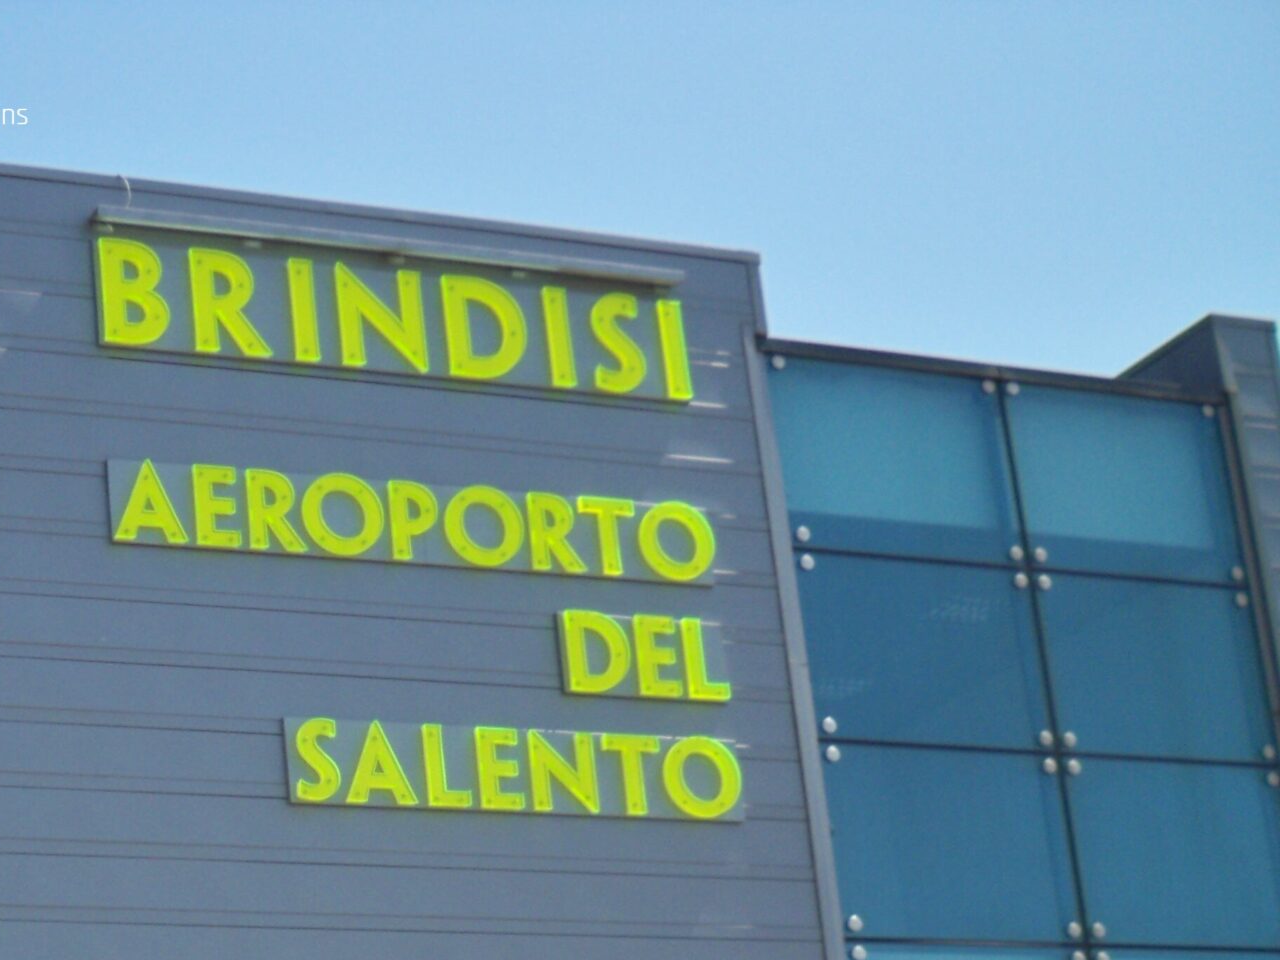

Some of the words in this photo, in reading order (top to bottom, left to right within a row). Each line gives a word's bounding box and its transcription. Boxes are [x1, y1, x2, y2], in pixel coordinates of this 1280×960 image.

[97, 236, 693, 399] BRINDISI
[113, 458, 716, 582] AEROPORTO
[562, 609, 732, 701] DEL
[295, 717, 742, 819] SALENTO
